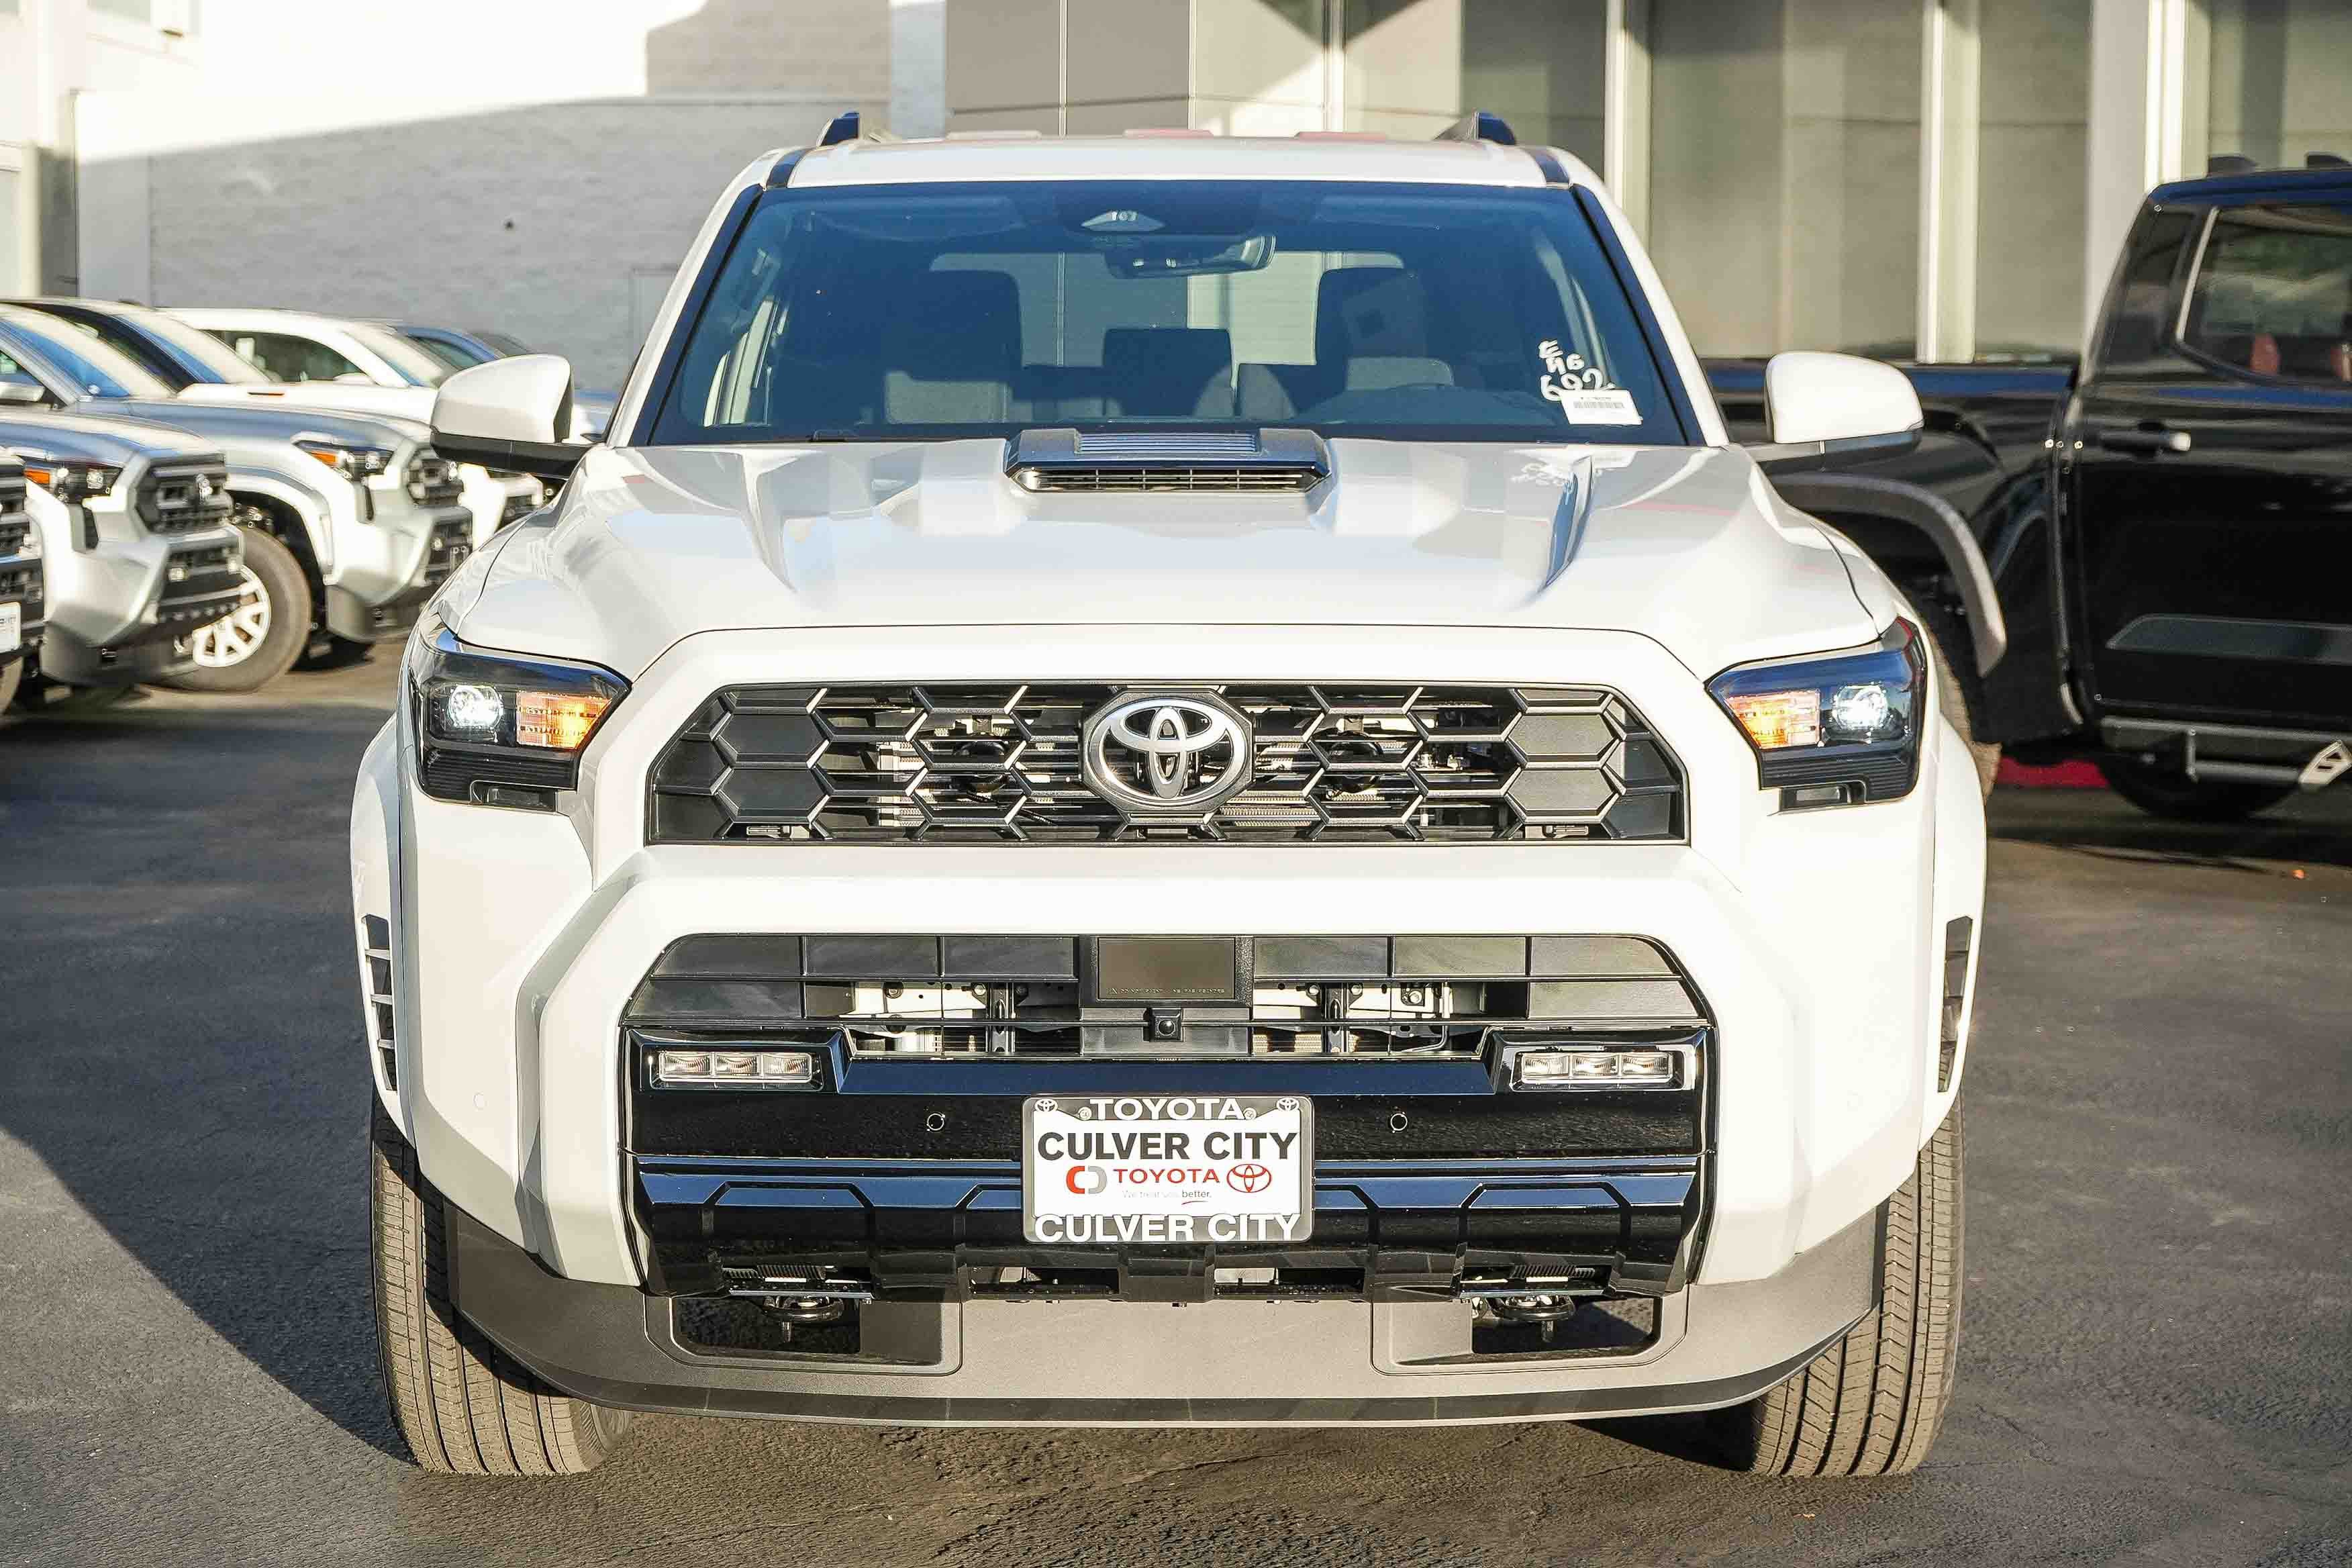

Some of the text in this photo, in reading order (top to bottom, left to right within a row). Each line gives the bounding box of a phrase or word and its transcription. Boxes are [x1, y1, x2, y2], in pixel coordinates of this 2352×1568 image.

[1090, 1097, 1245, 1120] TOYOTA
[1038, 1132, 1297, 1160] CULVER CITY
[1113, 1169, 1220, 1183] TOYOTA
[1182, 1190, 1212, 1198] better.
[1034, 1214, 1300, 1242] CULVER CITY
